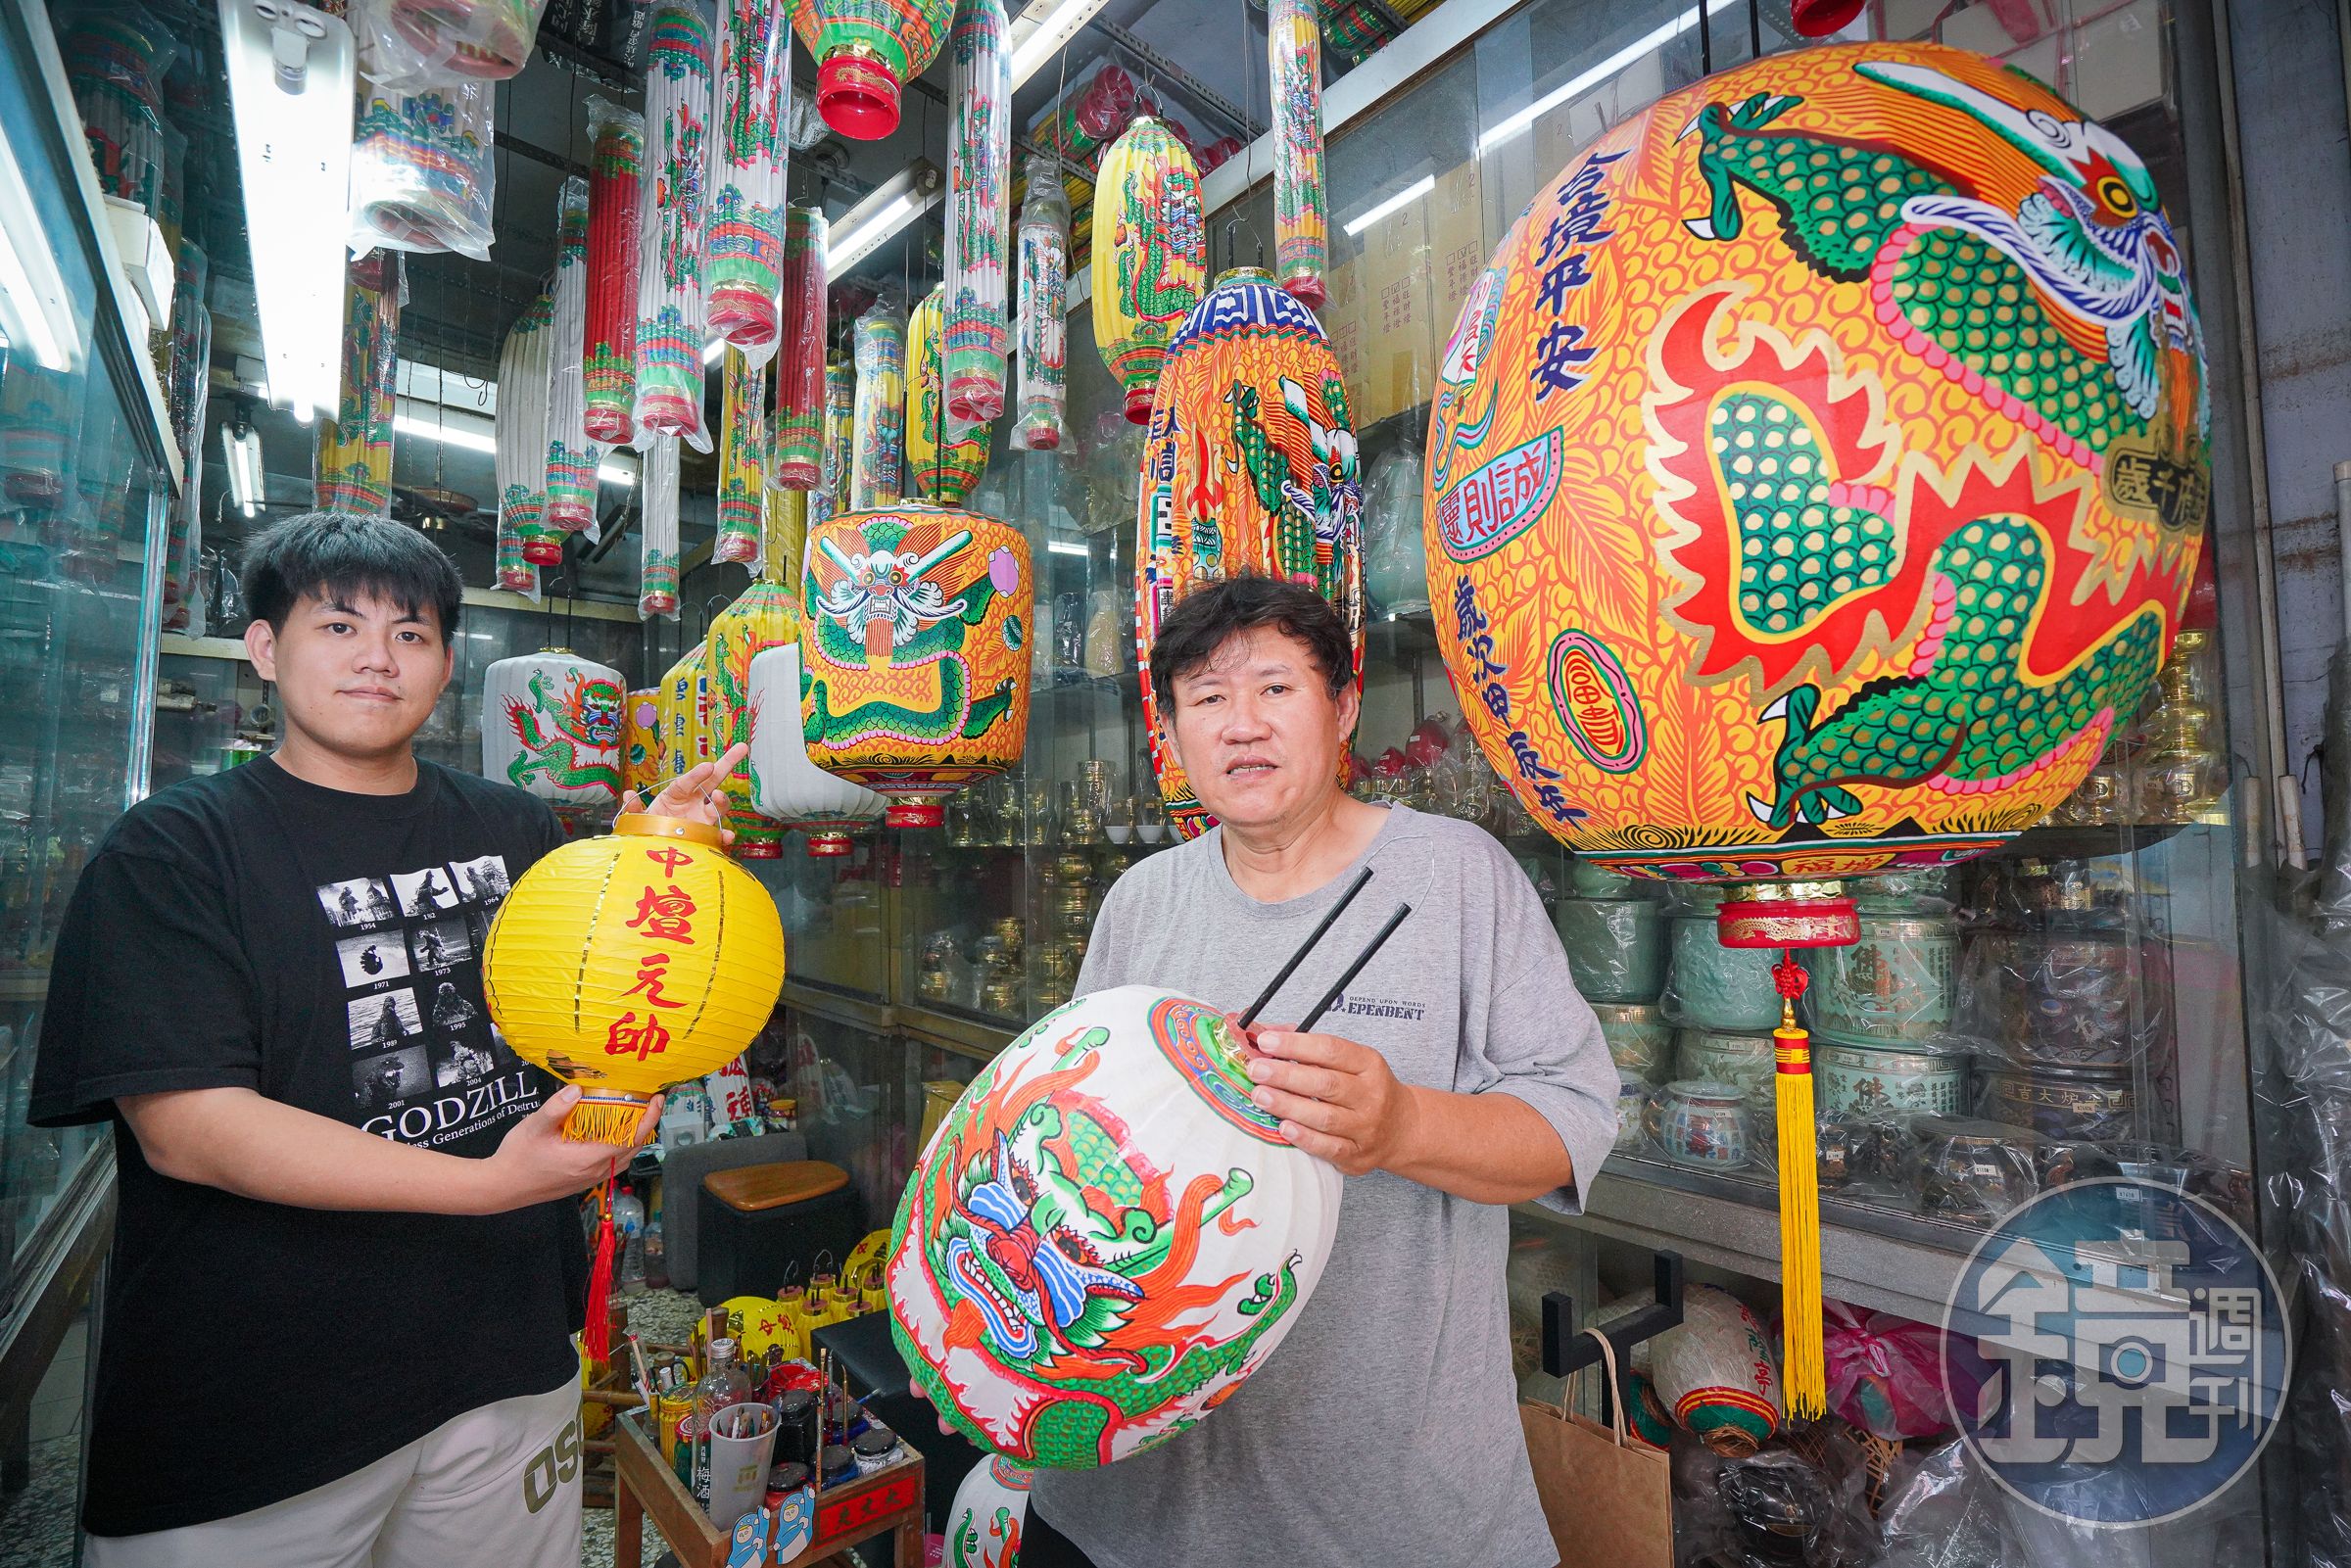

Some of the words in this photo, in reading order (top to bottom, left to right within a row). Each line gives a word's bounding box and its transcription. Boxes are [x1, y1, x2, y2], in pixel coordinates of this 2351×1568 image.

[1531, 149, 1630, 402] 合境平安
[484, 896, 500, 906] 1964
[604, 846, 694, 1062] 中壇元帥
[434, 968, 451, 976] 1973
[450, 1022, 466, 1031] 1995
[466, 1077, 482, 1086] 2004
[388, 1100, 405, 1110] 2001
[432, 1117, 497, 1145] Generations
[497, 1107, 506, 1119] of
[696, 1467, 710, 1498] 梅酒
